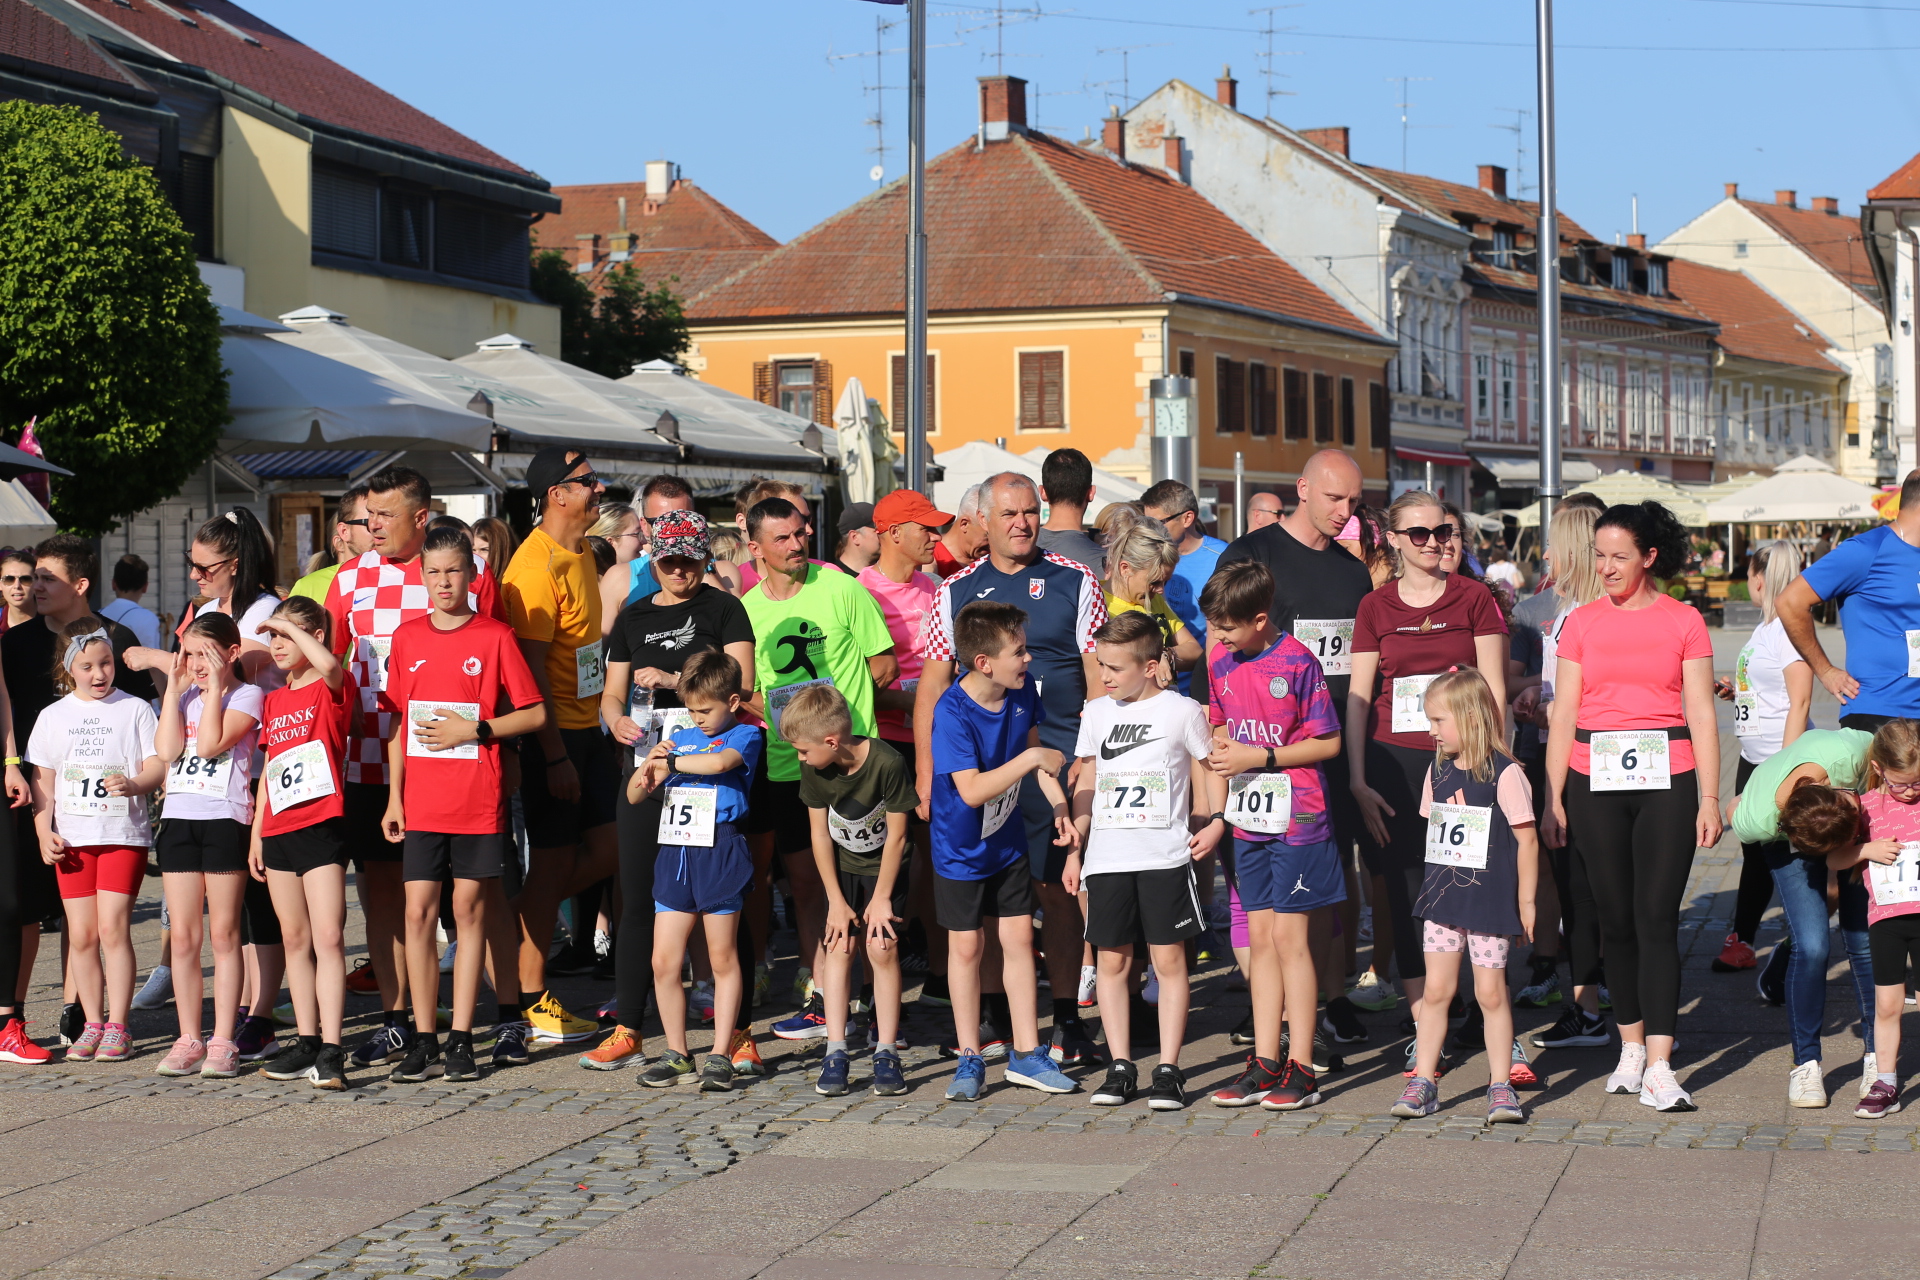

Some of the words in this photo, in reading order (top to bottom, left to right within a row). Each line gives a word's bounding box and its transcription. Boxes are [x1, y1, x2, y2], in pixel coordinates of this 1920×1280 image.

[1432, 622, 1447, 630] HALF
[1318, 635, 1343, 657] 19
[83, 718, 100, 726] KAD
[269, 705, 318, 734] ZRINSK
[68, 727, 114, 736] NARASTEM
[92, 737, 105, 746] ĆU
[1108, 724, 1152, 744] NIKE
[74, 747, 104, 757] TRČATI
[1621, 748, 1638, 770] 6
[104, 763, 126, 771] ČAKOVCA
[176, 756, 218, 778] 184
[280, 762, 304, 790] 62
[1262, 774, 1288, 782] ČAKOVCA
[81, 777, 109, 799] 18
[688, 788, 713, 797] ČAKOVCA
[1114, 786, 1146, 808] 72
[1237, 790, 1274, 813] 101
[1460, 808, 1487, 816] ČAKOVCA
[669, 804, 693, 826] 15
[840, 818, 886, 842] 146
[1438, 822, 1466, 846] 16
